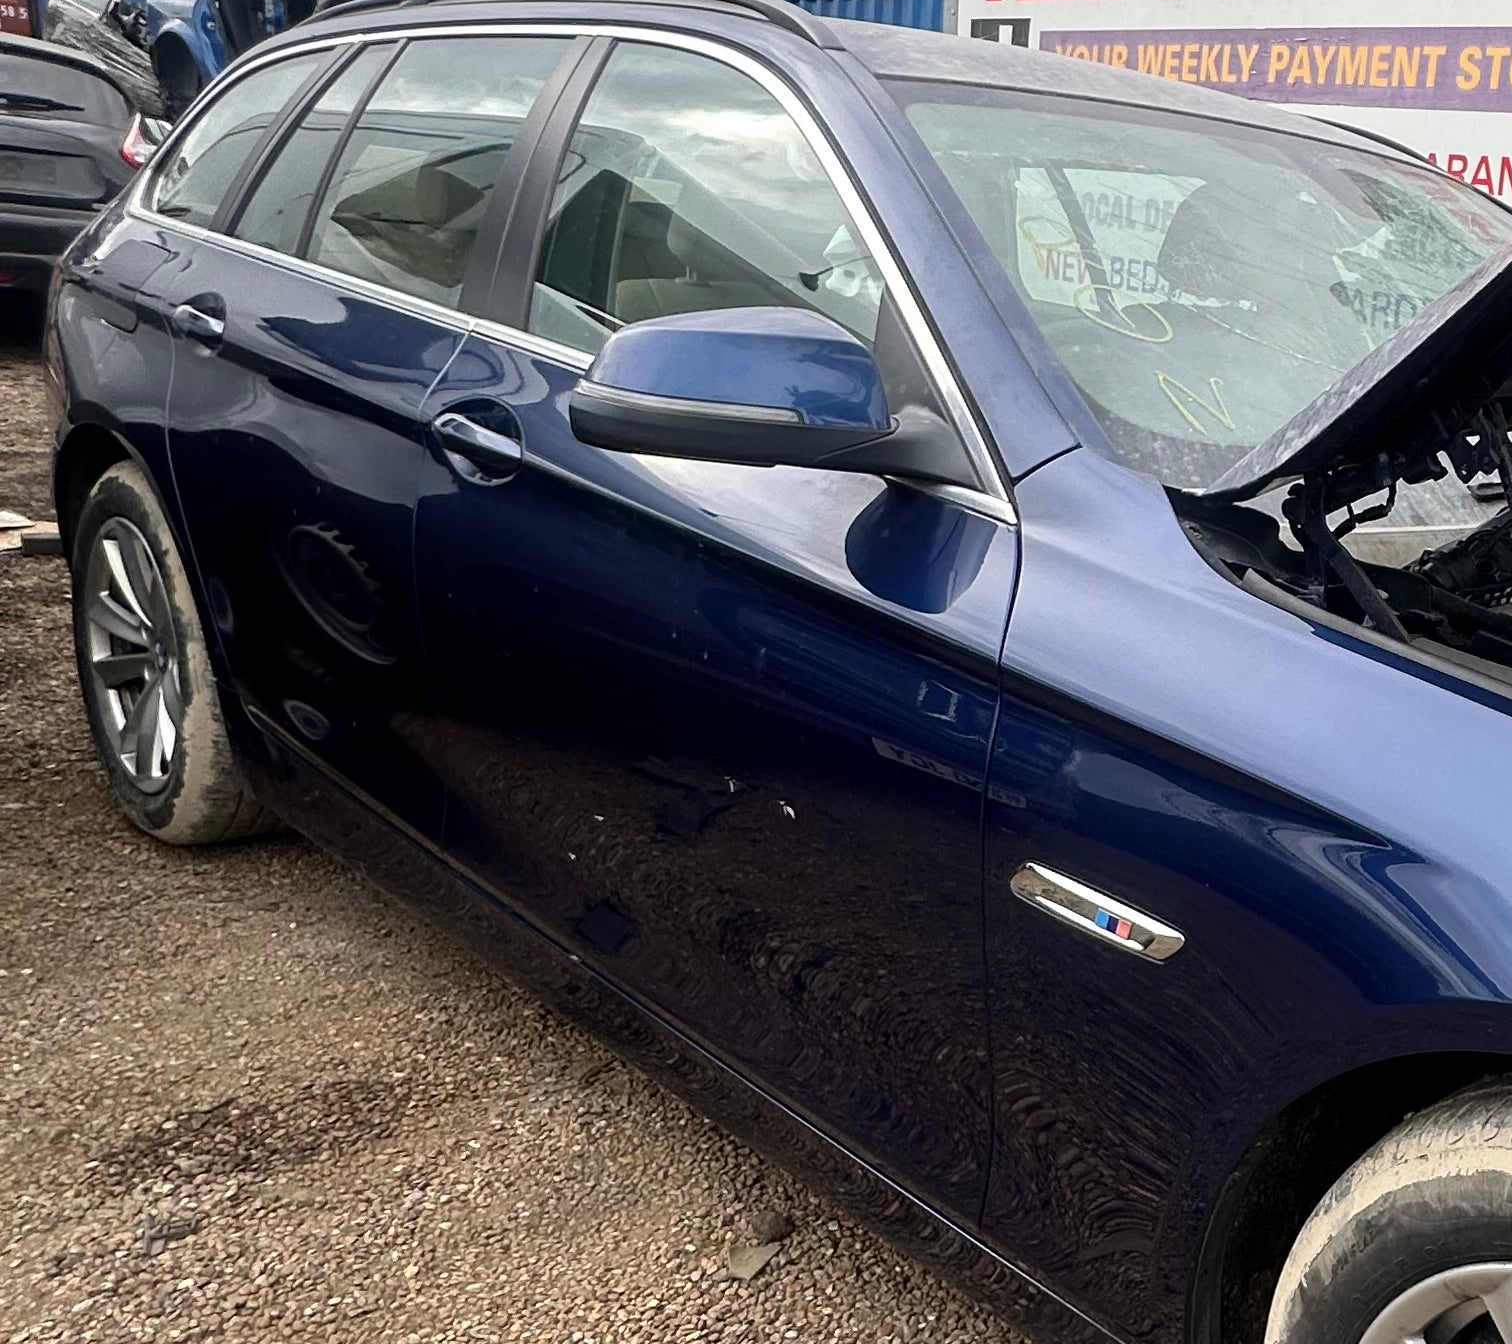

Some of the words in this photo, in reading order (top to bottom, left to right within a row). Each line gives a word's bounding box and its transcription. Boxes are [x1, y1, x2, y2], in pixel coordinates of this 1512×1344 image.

[1137, 42, 1259, 83] WEEKLY
[1267, 44, 1448, 89] PAYMENT
[1081, 191, 1136, 230] OCAL
[1110, 256, 1160, 294] BED
[1350, 287, 1420, 330] ARD
